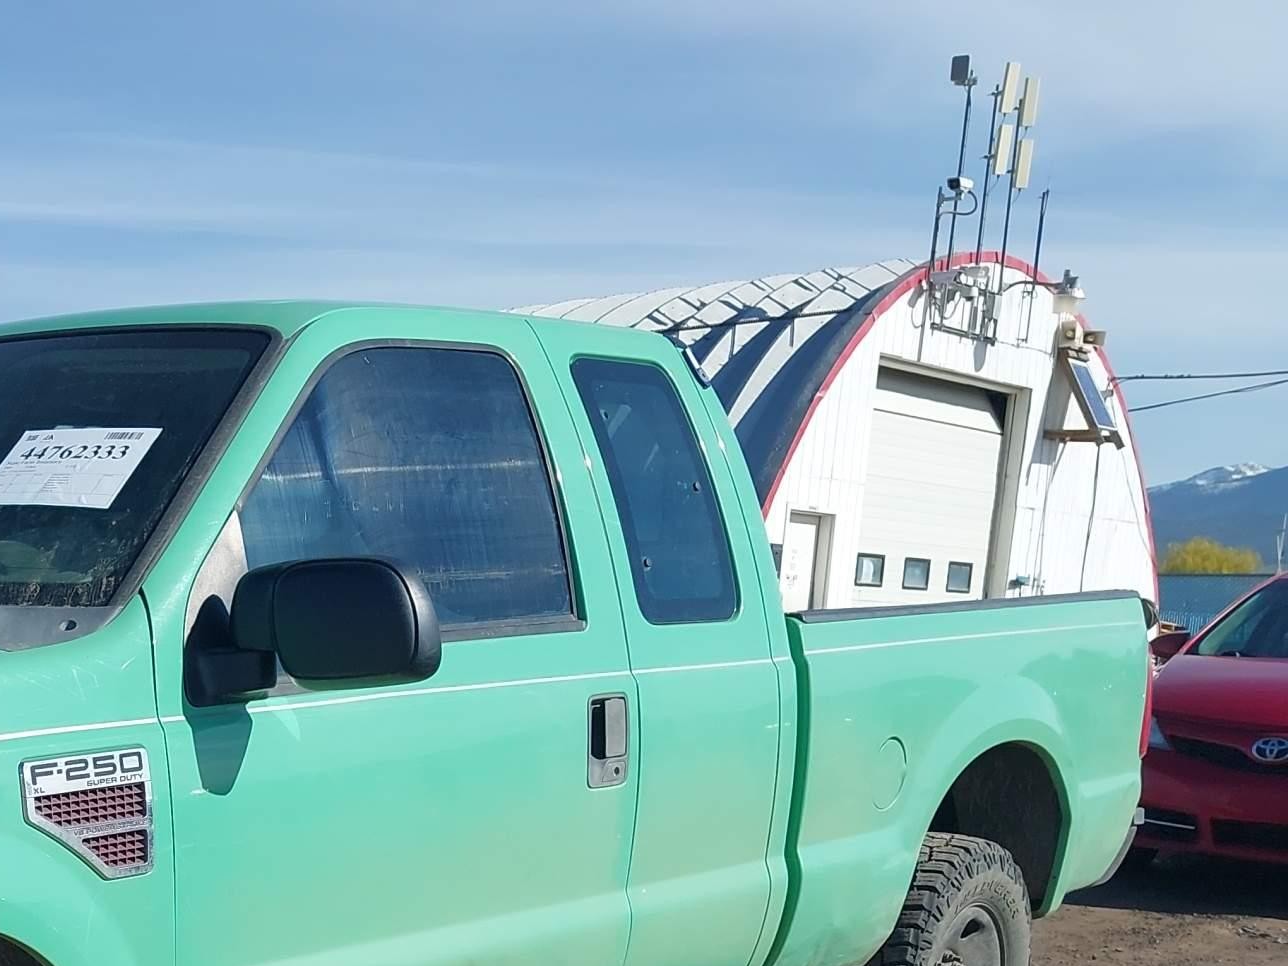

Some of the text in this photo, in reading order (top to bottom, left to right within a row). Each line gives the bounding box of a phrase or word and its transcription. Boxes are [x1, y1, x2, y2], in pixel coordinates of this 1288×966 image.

[20, 445, 131, 460] 44762333
[30, 751, 144, 785] F-250
[87, 773, 144, 787] SUPER DUTY
[33, 787, 46, 795] XL
